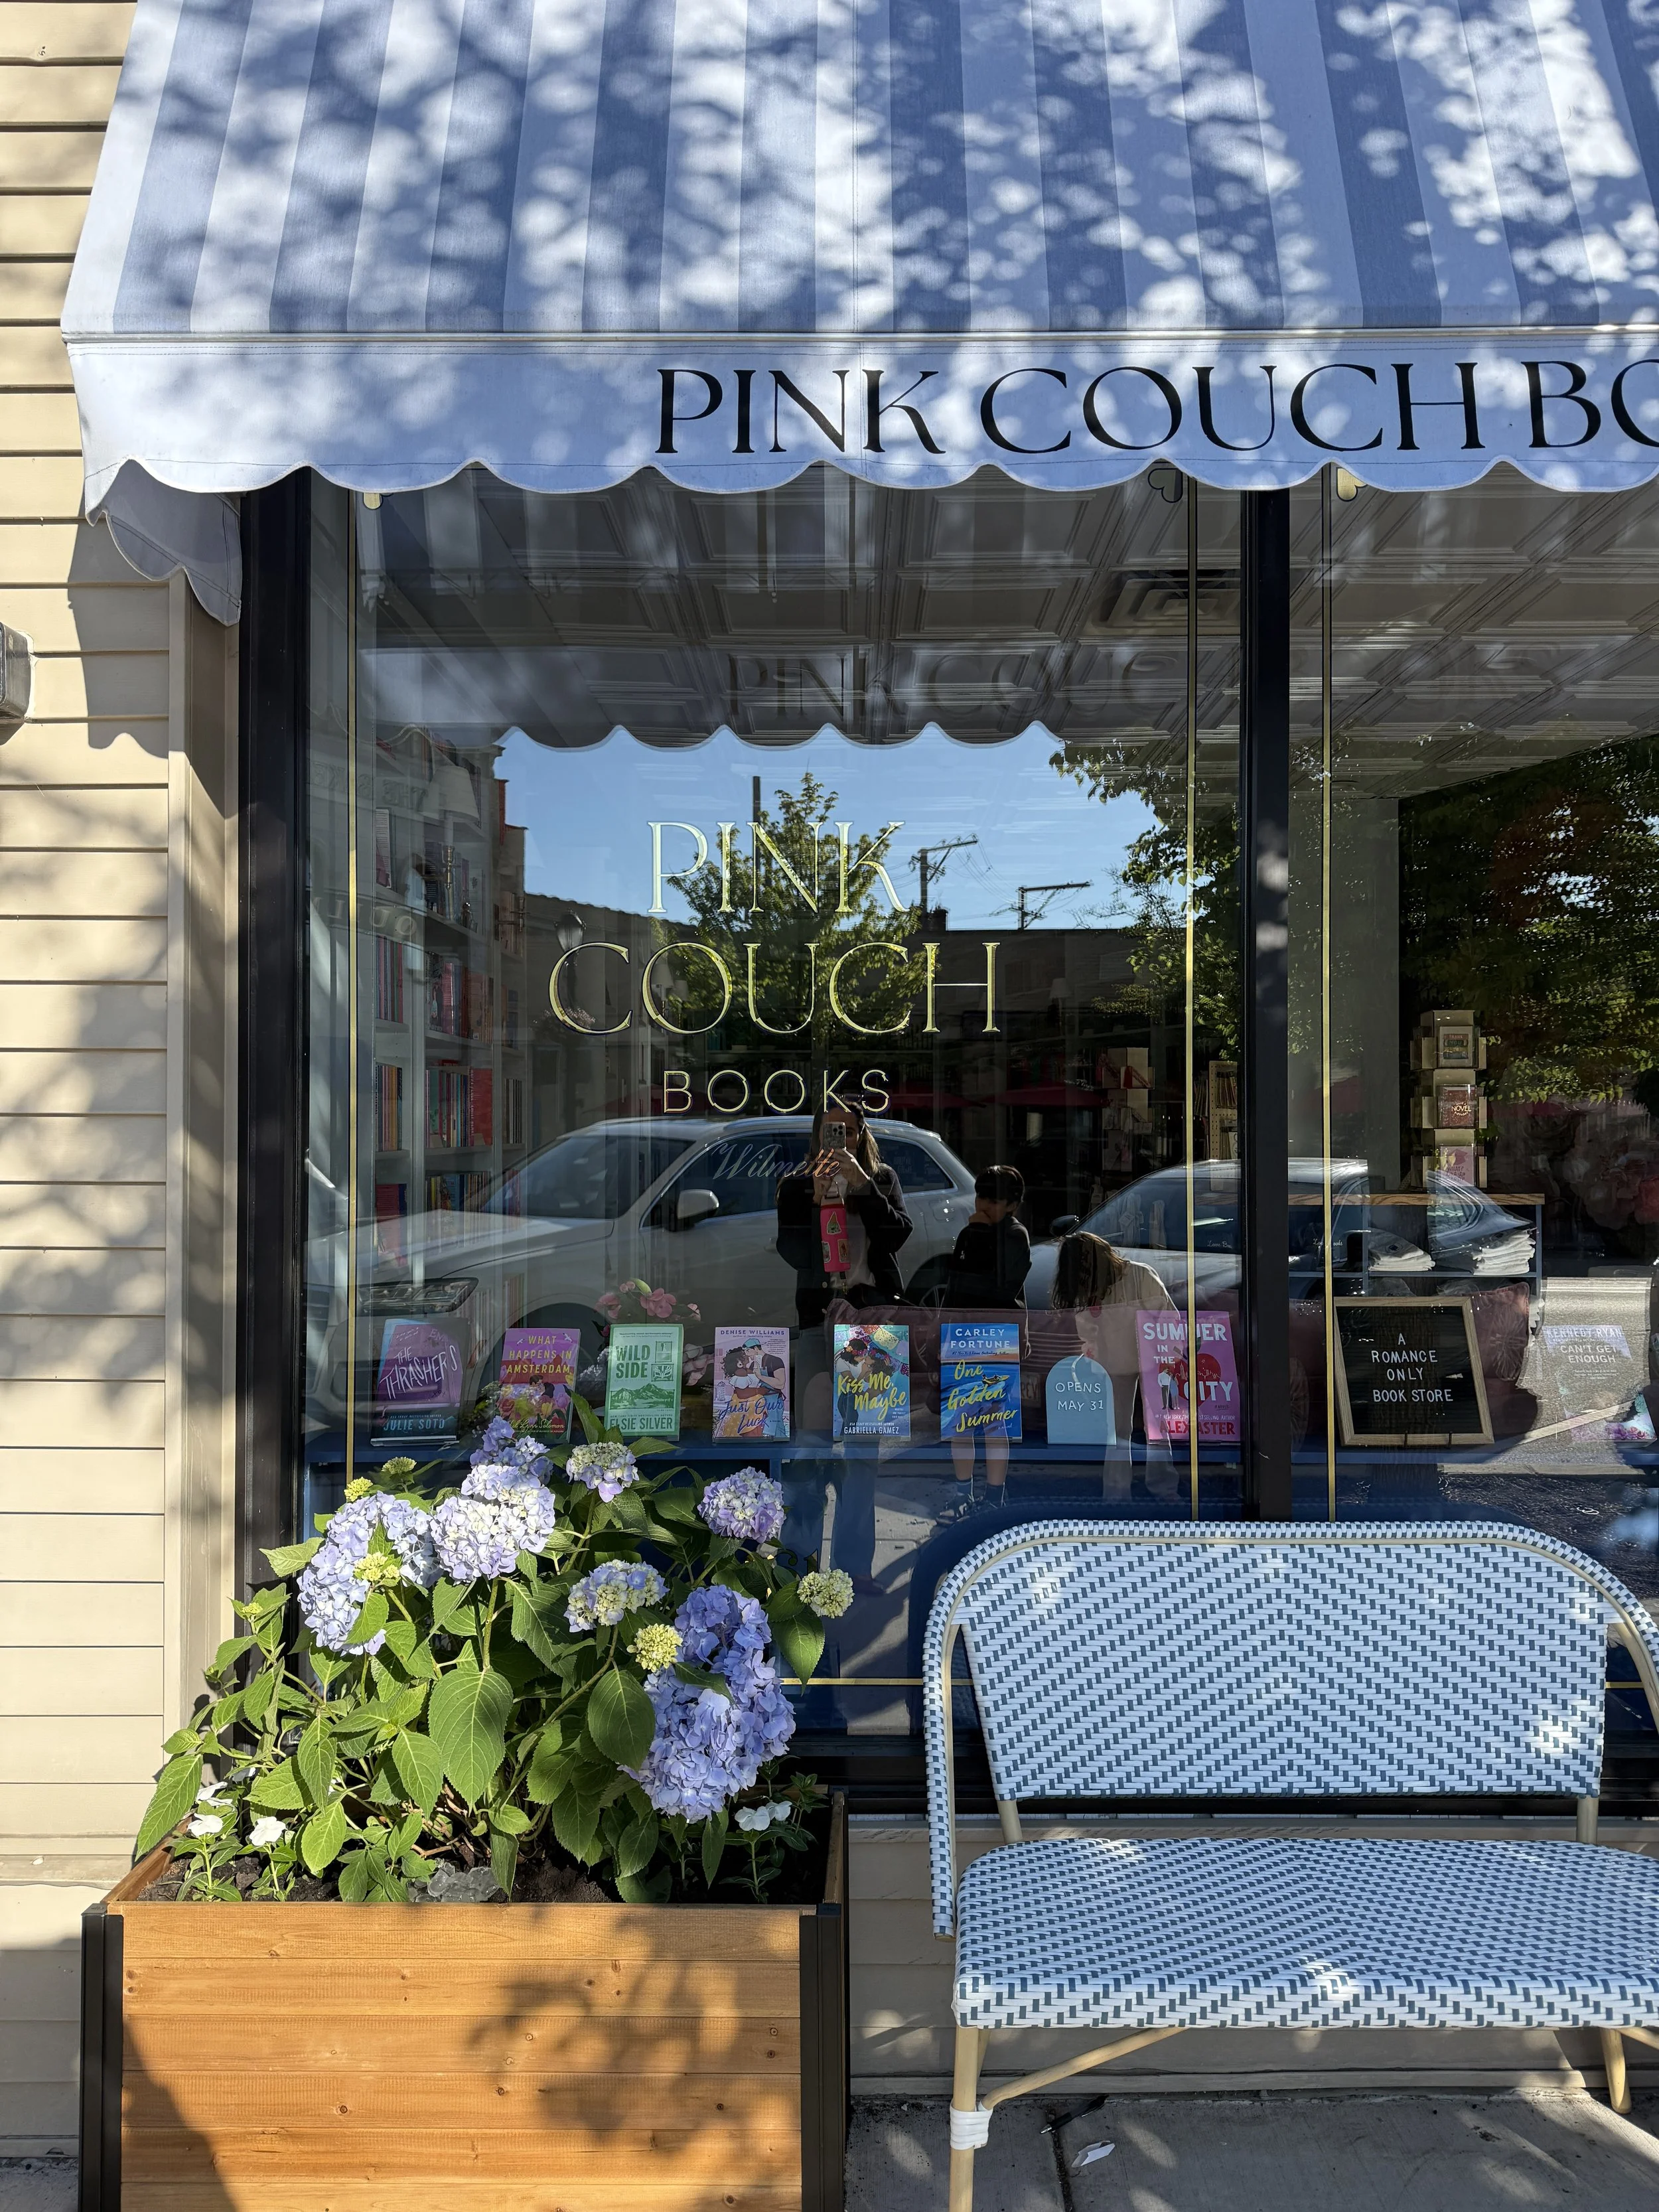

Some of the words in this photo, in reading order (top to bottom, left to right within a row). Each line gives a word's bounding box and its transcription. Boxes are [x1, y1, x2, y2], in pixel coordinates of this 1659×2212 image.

[655, 368, 946, 454] PINK
[980, 362, 1486, 453] COUCH
[647, 821, 911, 914] PINK
[548, 942, 1001, 1035] COUCH
[663, 1069, 891, 1114] BOOKS
[711, 1142, 841, 1179] Wilmette
[528, 1335, 557, 1345] WHAT
[1398, 1333, 1406, 1345] A
[1547, 1327, 1592, 1337] KENNEDY
[1596, 1327, 1623, 1338] RYAN
[394, 1346, 413, 1365] THE
[509, 1350, 557, 1359] HAPPENS
[561, 1350, 572, 1359] IN
[615, 1345, 651, 1361] WILD
[1371, 1350, 1438, 1363] ROMANCE
[1559, 1345, 1592, 1353] CAN'T
[1596, 1345, 1617, 1353] GET
[1567, 1355, 1617, 1363] ENOUGH
[379, 1345, 458, 1400] THRASHERS
[506, 1364, 570, 1374] AMSTERDAM
[616, 1361, 648, 1379] SIDE
[954, 1359, 983, 1380] One
[1386, 1367, 1423, 1381] ONLY
[837, 1374, 864, 1397] Kiss
[1055, 1381, 1102, 1393] OPENS
[854, 1386, 907, 1421] Maybe
[947, 1384, 1006, 1410] Golden
[1373, 1389, 1407, 1402] BOOK
[1411, 1389, 1453, 1402] STORE
[718, 1400, 755, 1420] Just
[755, 1396, 784, 1415] Our
[1058, 1400, 1085, 1412] MAY
[1090, 1400, 1104, 1411] 31
[383, 1420, 413, 1431] JULIE
[418, 1418, 445, 1430] SOTO
[639, 1417, 673, 1430] SILVER
[737, 1413, 770, 1434] Luck
[956, 1409, 1018, 1433] Summer
